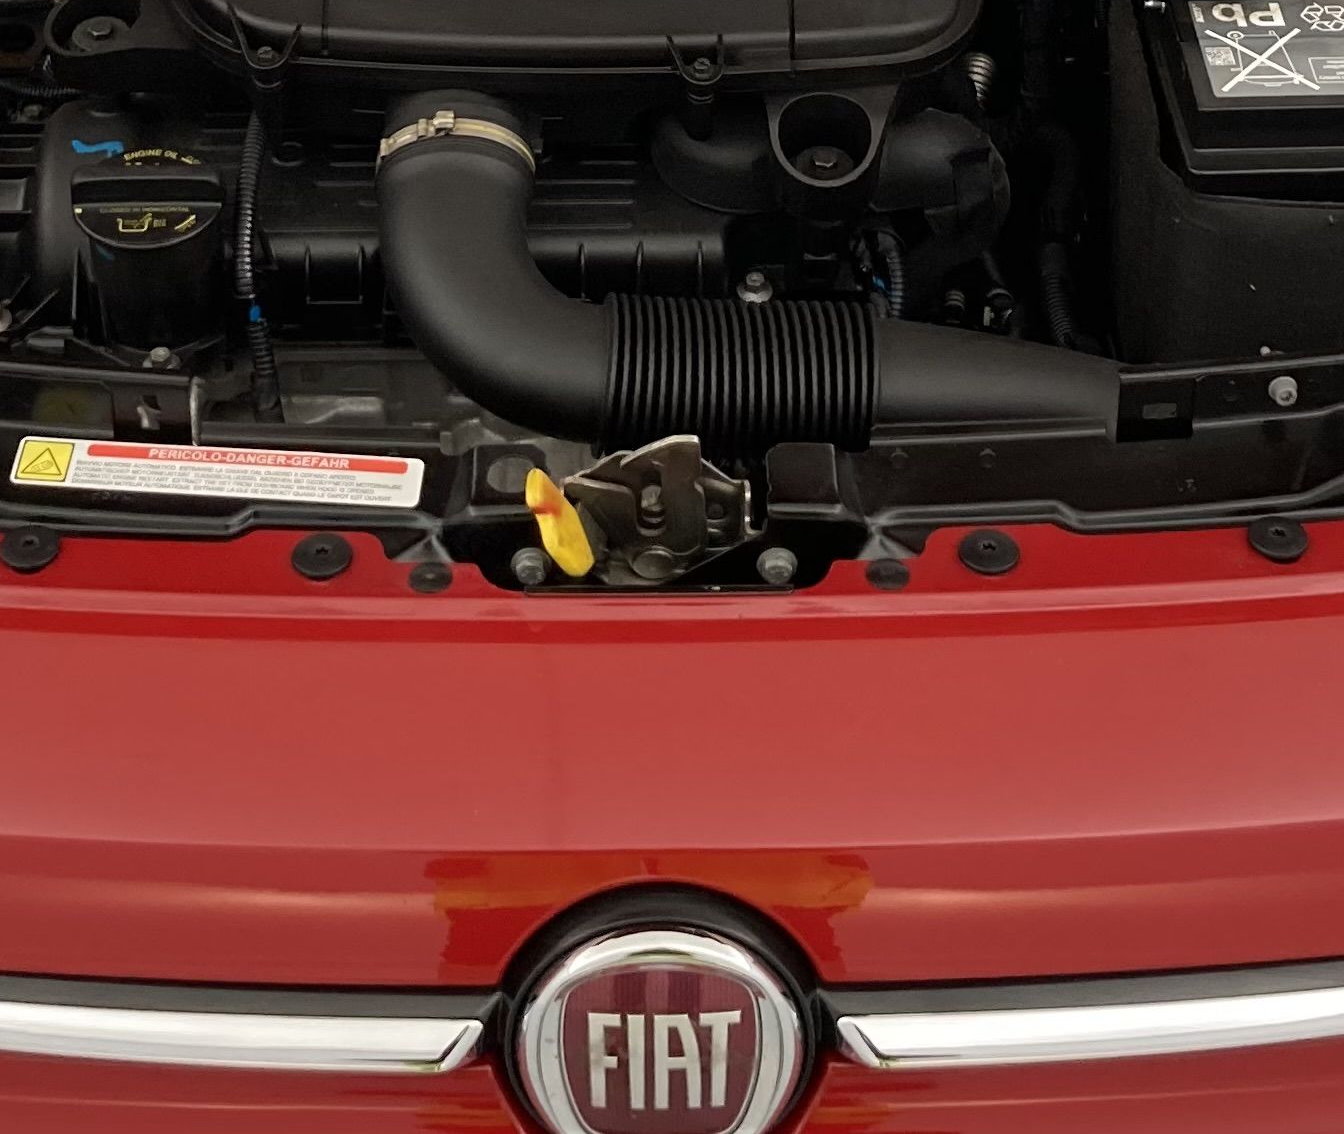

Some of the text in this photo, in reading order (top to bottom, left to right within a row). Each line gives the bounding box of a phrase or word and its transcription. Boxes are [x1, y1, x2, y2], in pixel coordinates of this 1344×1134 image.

[1212, 2, 1286, 27] Pb
[148, 448, 351, 470] PERICOLO-DANGER-GEFAHR
[586, 1010, 742, 1110] FIAT
